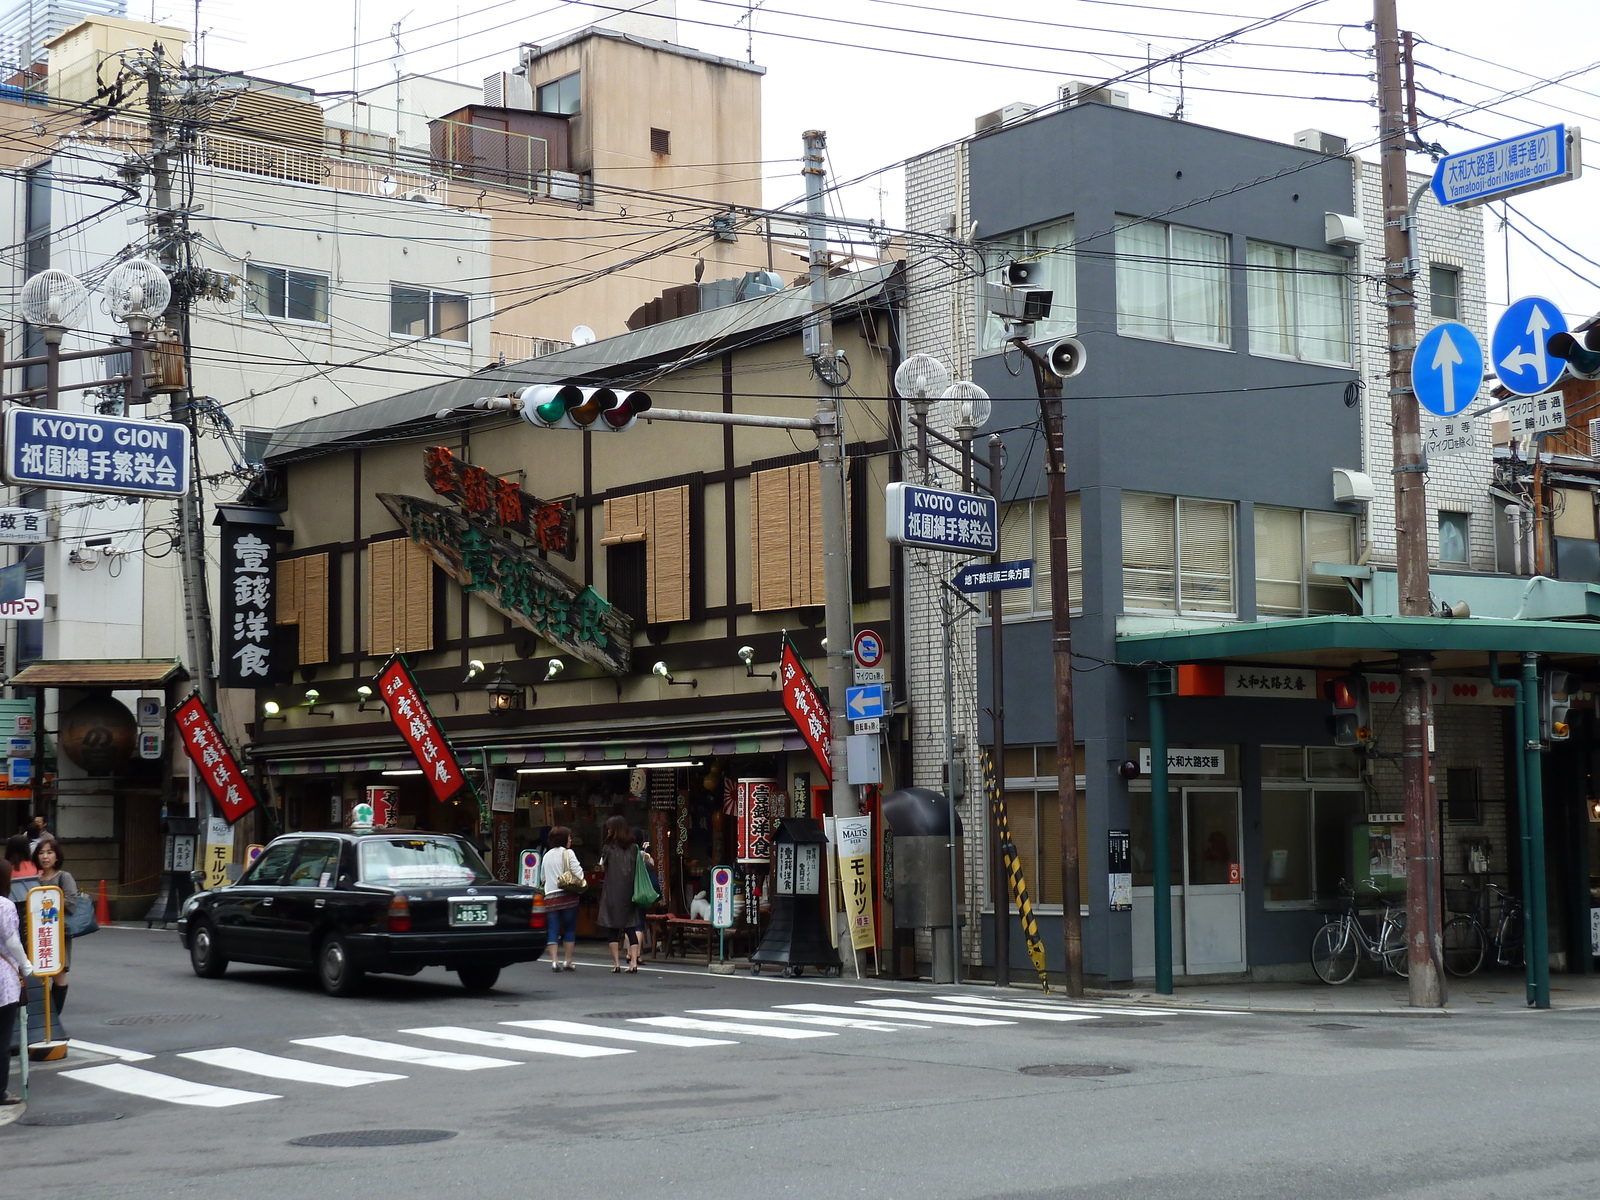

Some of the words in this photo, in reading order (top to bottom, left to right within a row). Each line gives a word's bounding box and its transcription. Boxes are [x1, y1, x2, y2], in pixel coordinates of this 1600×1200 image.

[32, 418, 103, 443] KYOTO
[114, 428, 168, 449] GION
[21, 443, 177, 487] 祇園縄手繁栄会
[914, 492, 953, 511] KYOTO
[958, 499, 987, 517] GION
[908, 512, 992, 547] 祇園縄手繁栄会
[964, 567, 1031, 586] 地下鉄京阪三条方面
[855, 671, 884, 681] マイクロを除く
[1236, 674, 1307, 691] 大和大路交番
[1167, 754, 1220, 768] 大和大路交番
[213, 846, 226, 886] モルツ
[850, 858, 866, 914] モルツ
[462, 910, 488, 922] 80-35
[38, 927, 53, 969] 駐車禁止
